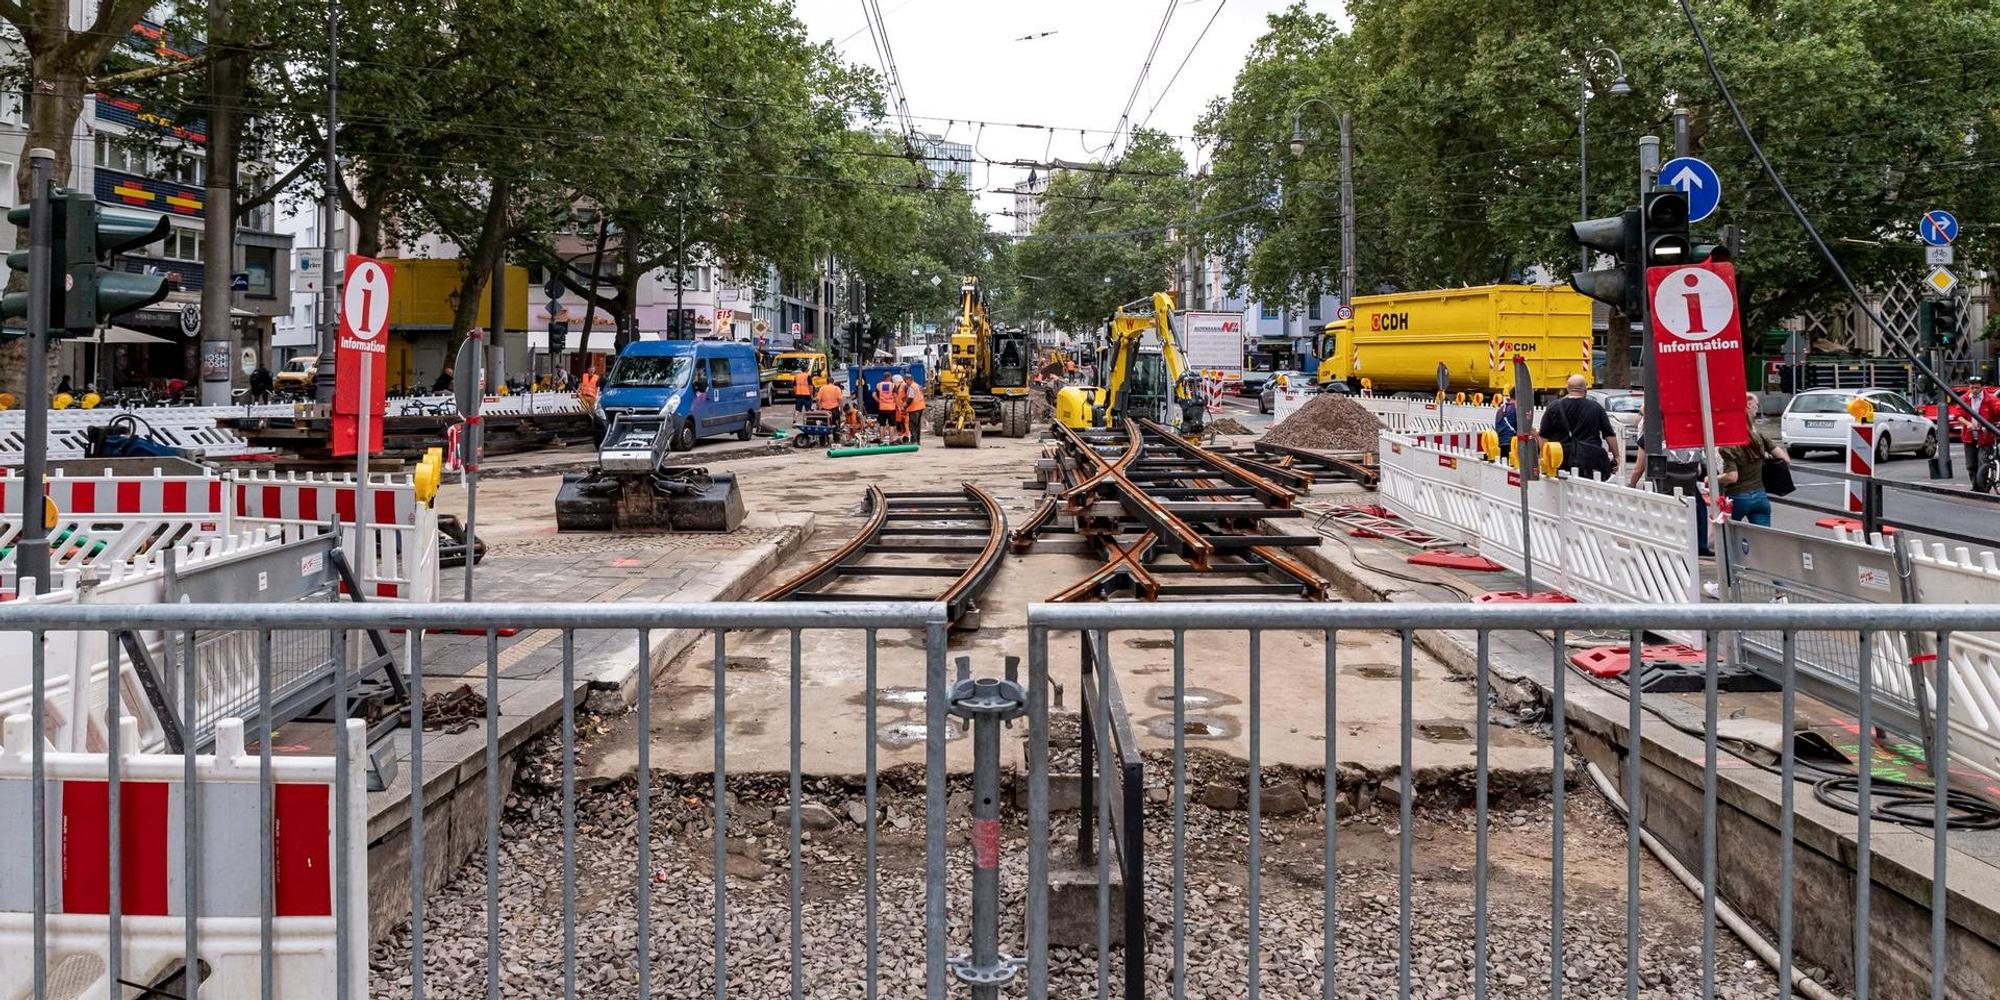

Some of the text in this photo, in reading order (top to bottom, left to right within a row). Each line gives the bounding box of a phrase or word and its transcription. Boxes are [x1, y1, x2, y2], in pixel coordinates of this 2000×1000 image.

[717, 310, 731, 319] EIS
[1382, 313, 1408, 330] CDH
[341, 336, 385, 353] Information
[1514, 343, 1536, 351] CDH
[1658, 338, 1739, 354] Information
